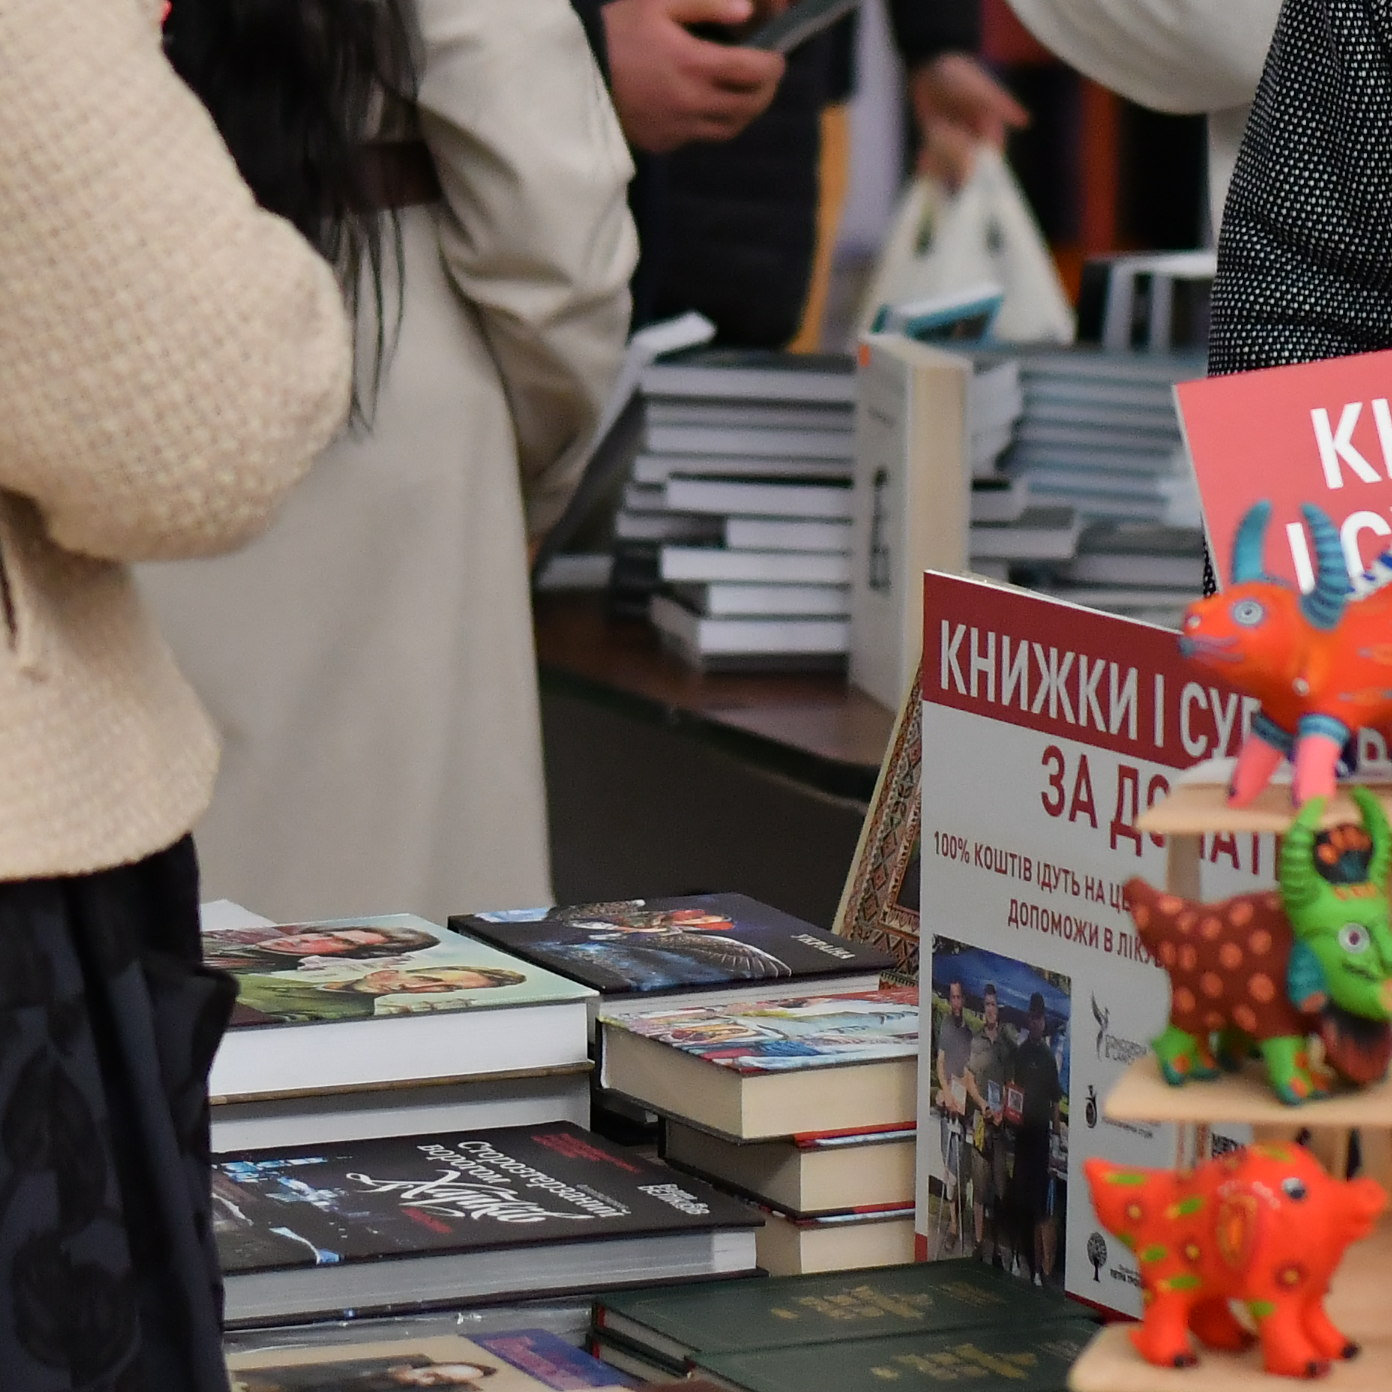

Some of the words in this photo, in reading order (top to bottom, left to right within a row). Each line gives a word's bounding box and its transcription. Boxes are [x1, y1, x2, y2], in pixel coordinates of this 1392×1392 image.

[941, 619, 1138, 741] КНИЖКИ
[1041, 744, 1098, 829] ЗА
[934, 830, 970, 864] 100%
[974, 841, 1033, 883] КОШТІВ
[1037, 860, 1080, 896] ІДУТЬ
[1085, 874, 1106, 905] НА
[1008, 898, 1099, 950] ДОПОМОЖИ
[1104, 927, 1113, 953] В
[416, 1143, 512, 1187] ворогом
